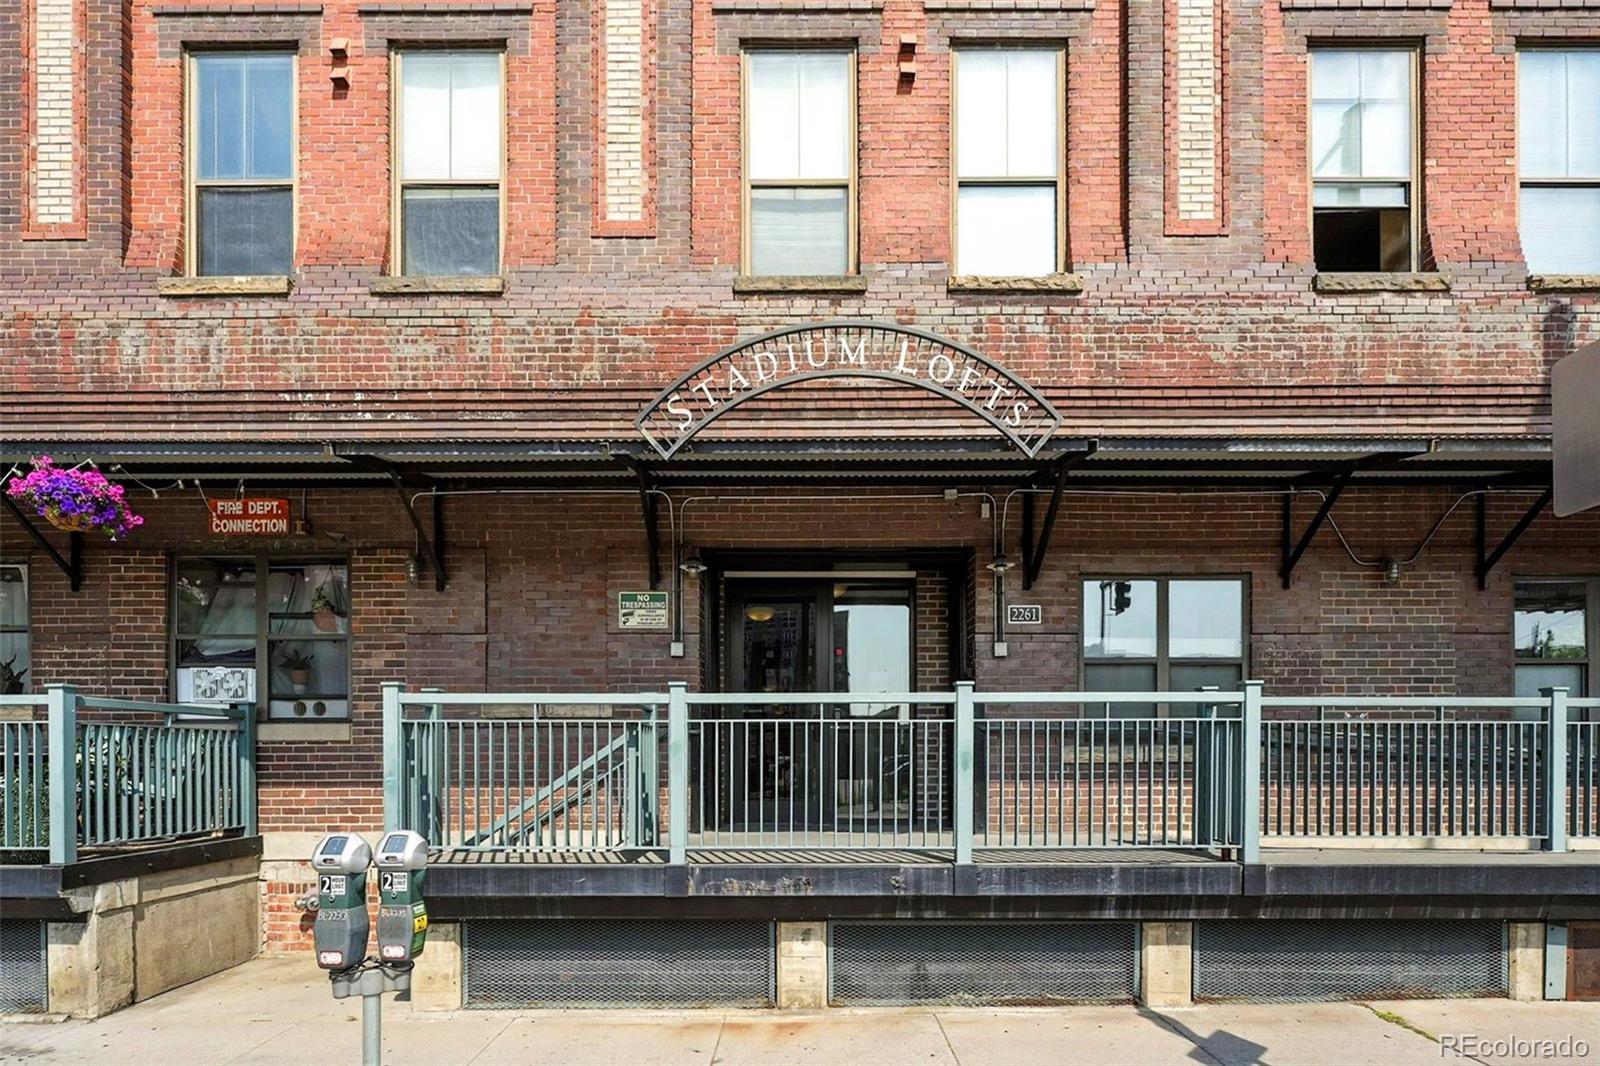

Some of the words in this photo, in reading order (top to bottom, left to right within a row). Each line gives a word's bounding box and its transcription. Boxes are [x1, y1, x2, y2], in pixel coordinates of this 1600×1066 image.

[667, 337, 868, 432] STADIUM
[895, 340, 1030, 427] LOFTS
[217, 501, 243, 514] FIRE
[248, 501, 282, 514] DEPT.
[212, 519, 287, 533] CONNECTION
[1012, 608, 1037, 620] 2261
[322, 877, 331, 893] 2
[383, 873, 392, 890] 2
